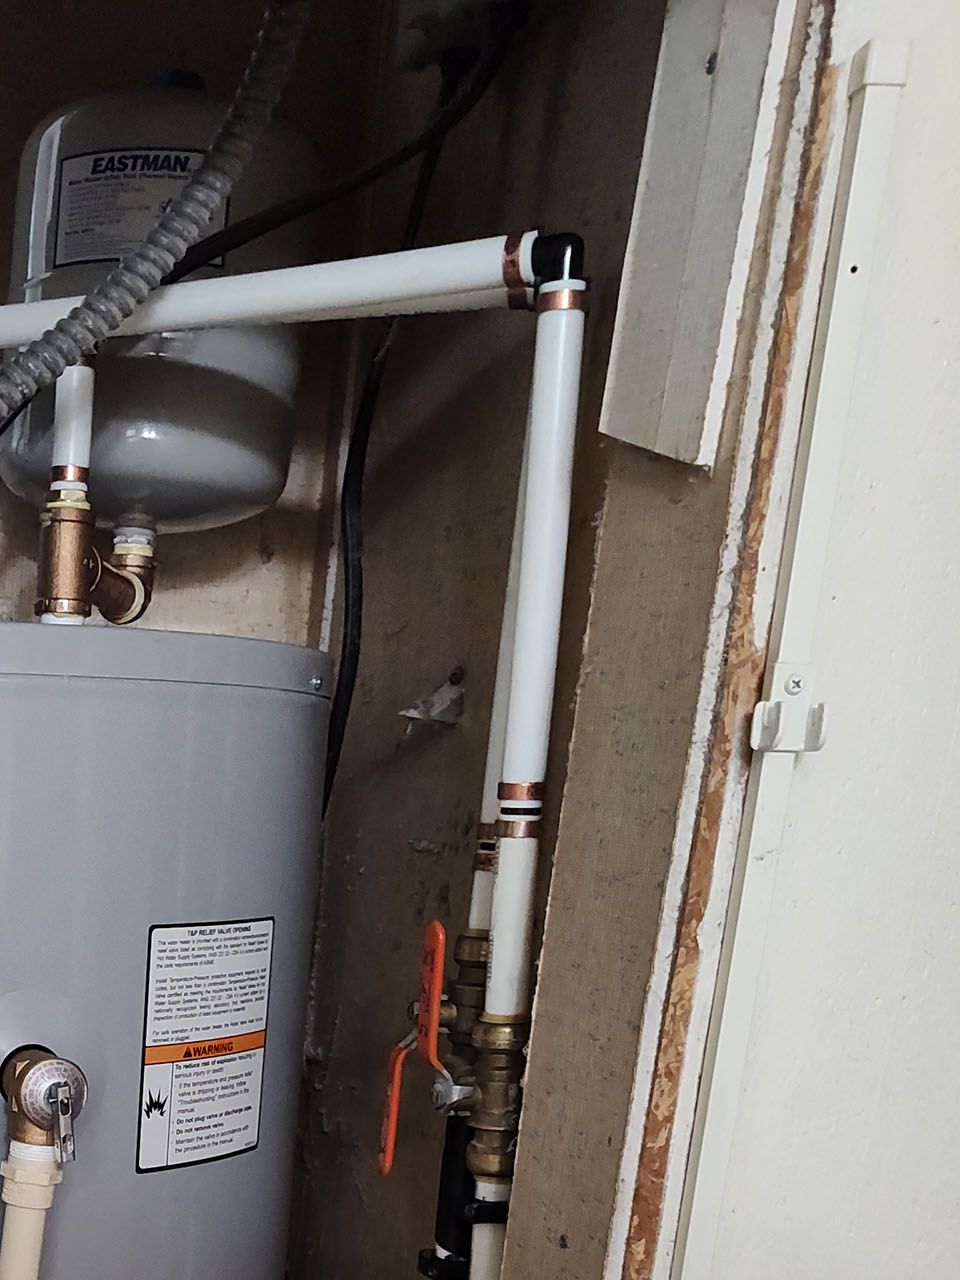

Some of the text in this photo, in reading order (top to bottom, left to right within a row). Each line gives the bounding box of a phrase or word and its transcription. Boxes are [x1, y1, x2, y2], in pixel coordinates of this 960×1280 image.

[91, 154, 190, 175] EASTMAN
[199, 928, 216, 936] RELIEF
[218, 927, 232, 935] VALVE
[192, 1042, 234, 1057] WARNING
